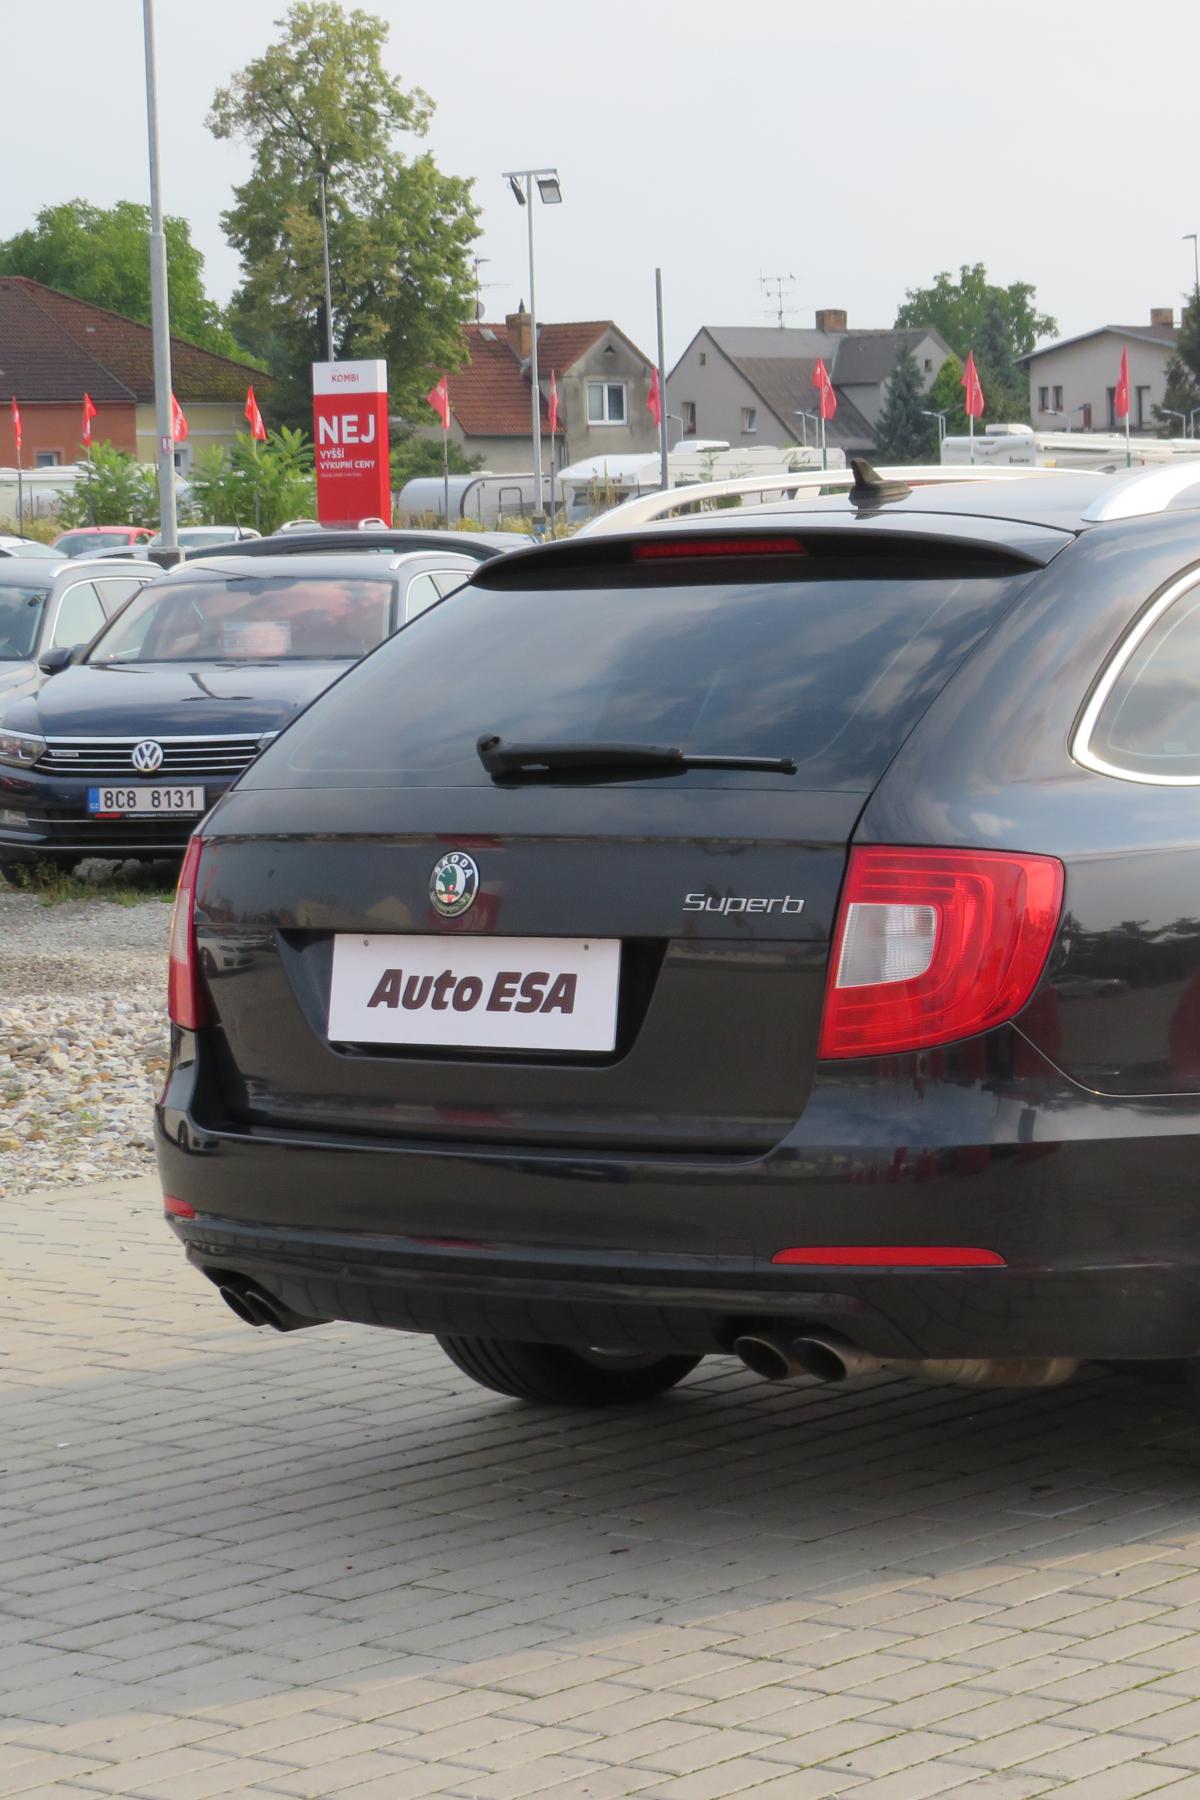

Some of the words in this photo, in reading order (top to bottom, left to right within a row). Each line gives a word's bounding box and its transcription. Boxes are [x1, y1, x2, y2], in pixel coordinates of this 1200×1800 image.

[331, 373, 359, 383] KOMBI
[318, 414, 375, 445] NEJ
[354, 460, 376, 469] CENY
[104, 790, 137, 808] 8C8
[151, 790, 195, 808] 8131
[682, 893, 805, 916] Superb
[367, 969, 483, 1012] Auto
[486, 971, 578, 1014] ESA
